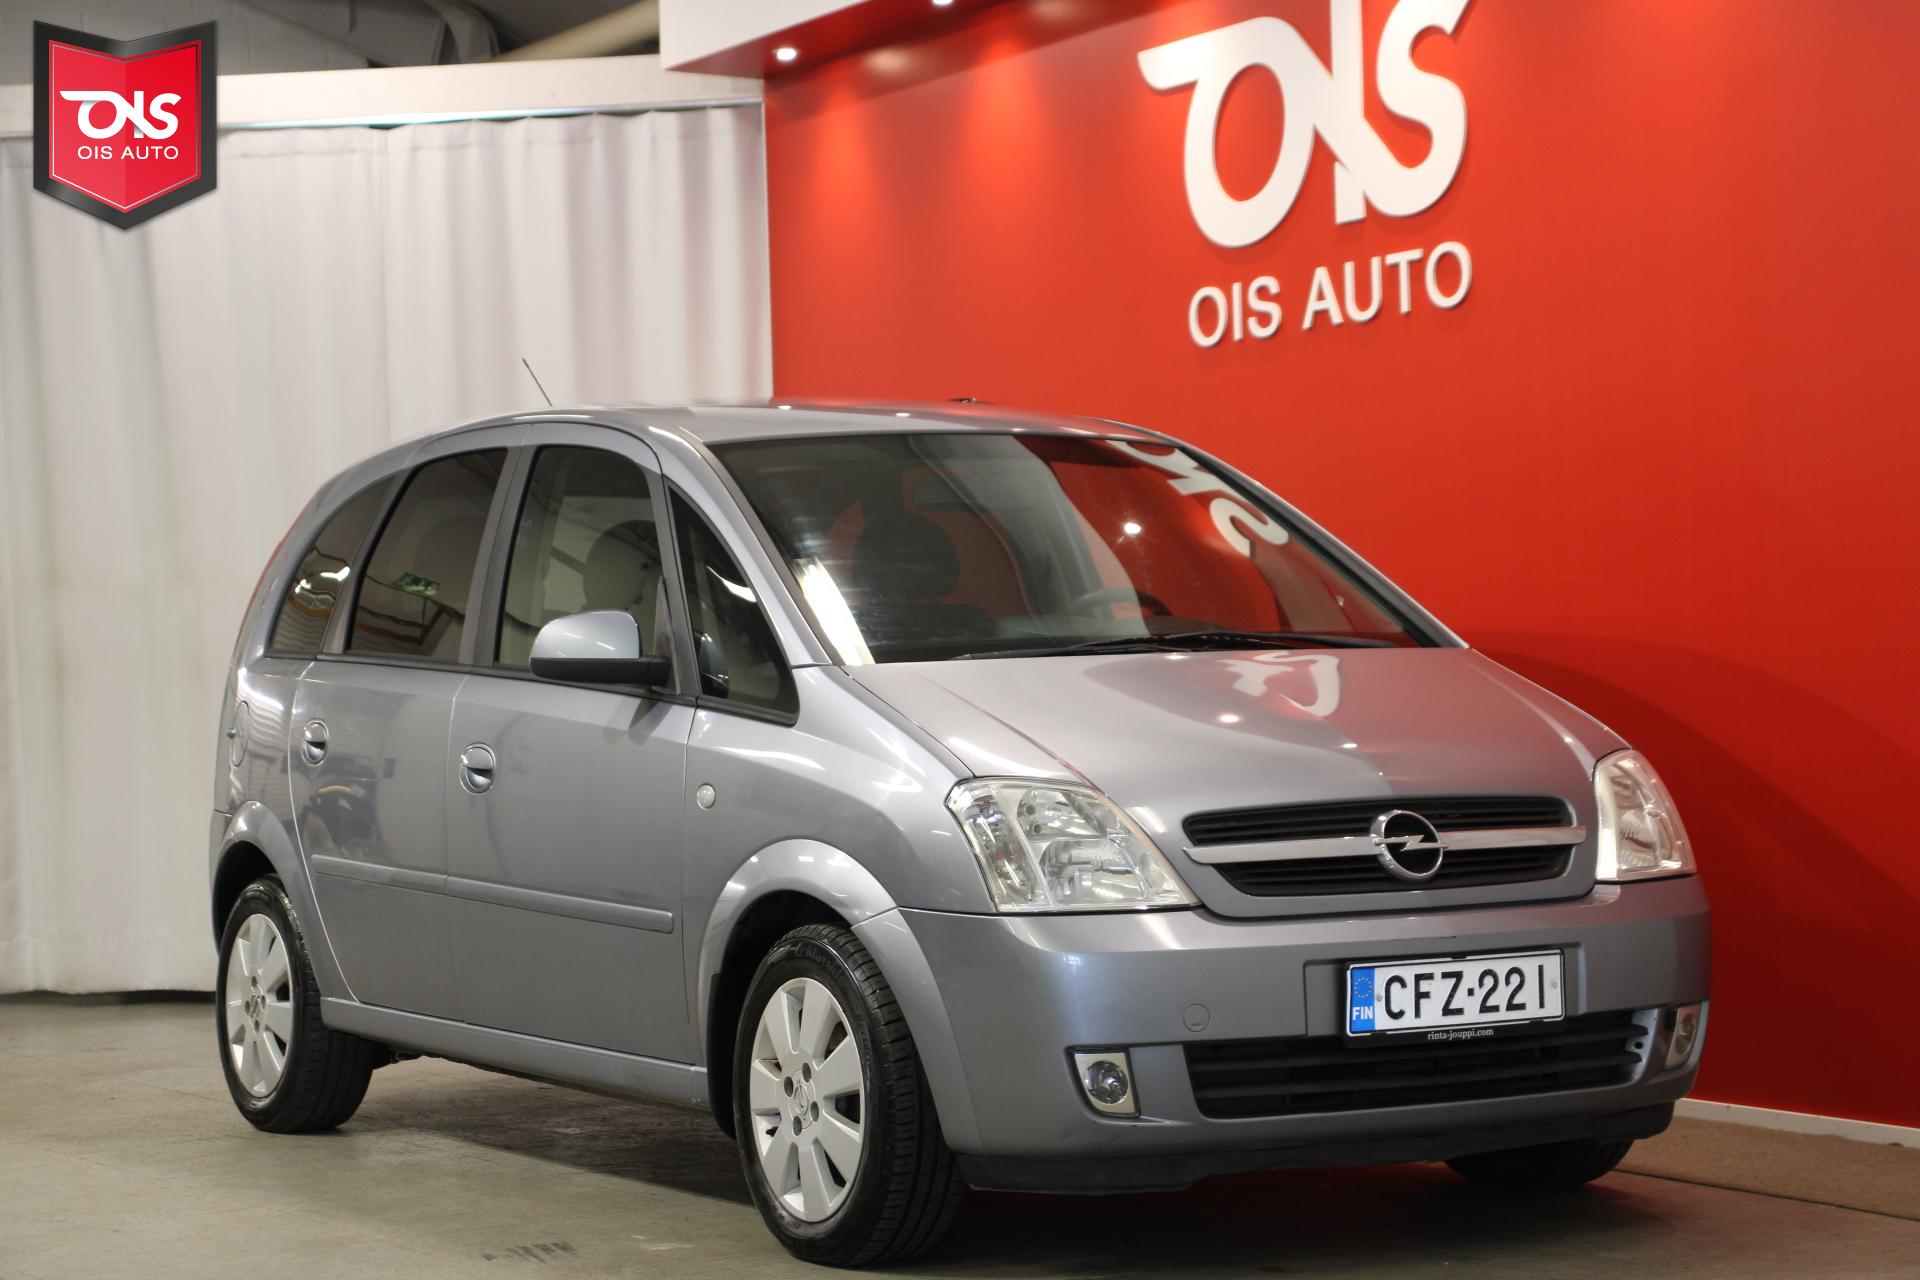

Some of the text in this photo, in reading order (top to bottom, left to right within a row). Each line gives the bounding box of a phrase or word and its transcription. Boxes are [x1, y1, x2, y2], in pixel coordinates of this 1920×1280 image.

[1137, 0, 1470, 248] OIS
[1188, 241, 1473, 348] OIS AUTO
[1352, 1005, 1374, 1021] FIN
[1384, 963, 1546, 1020] CFZ-221
[1427, 1027, 1495, 1041] rinta-jouppi.com
